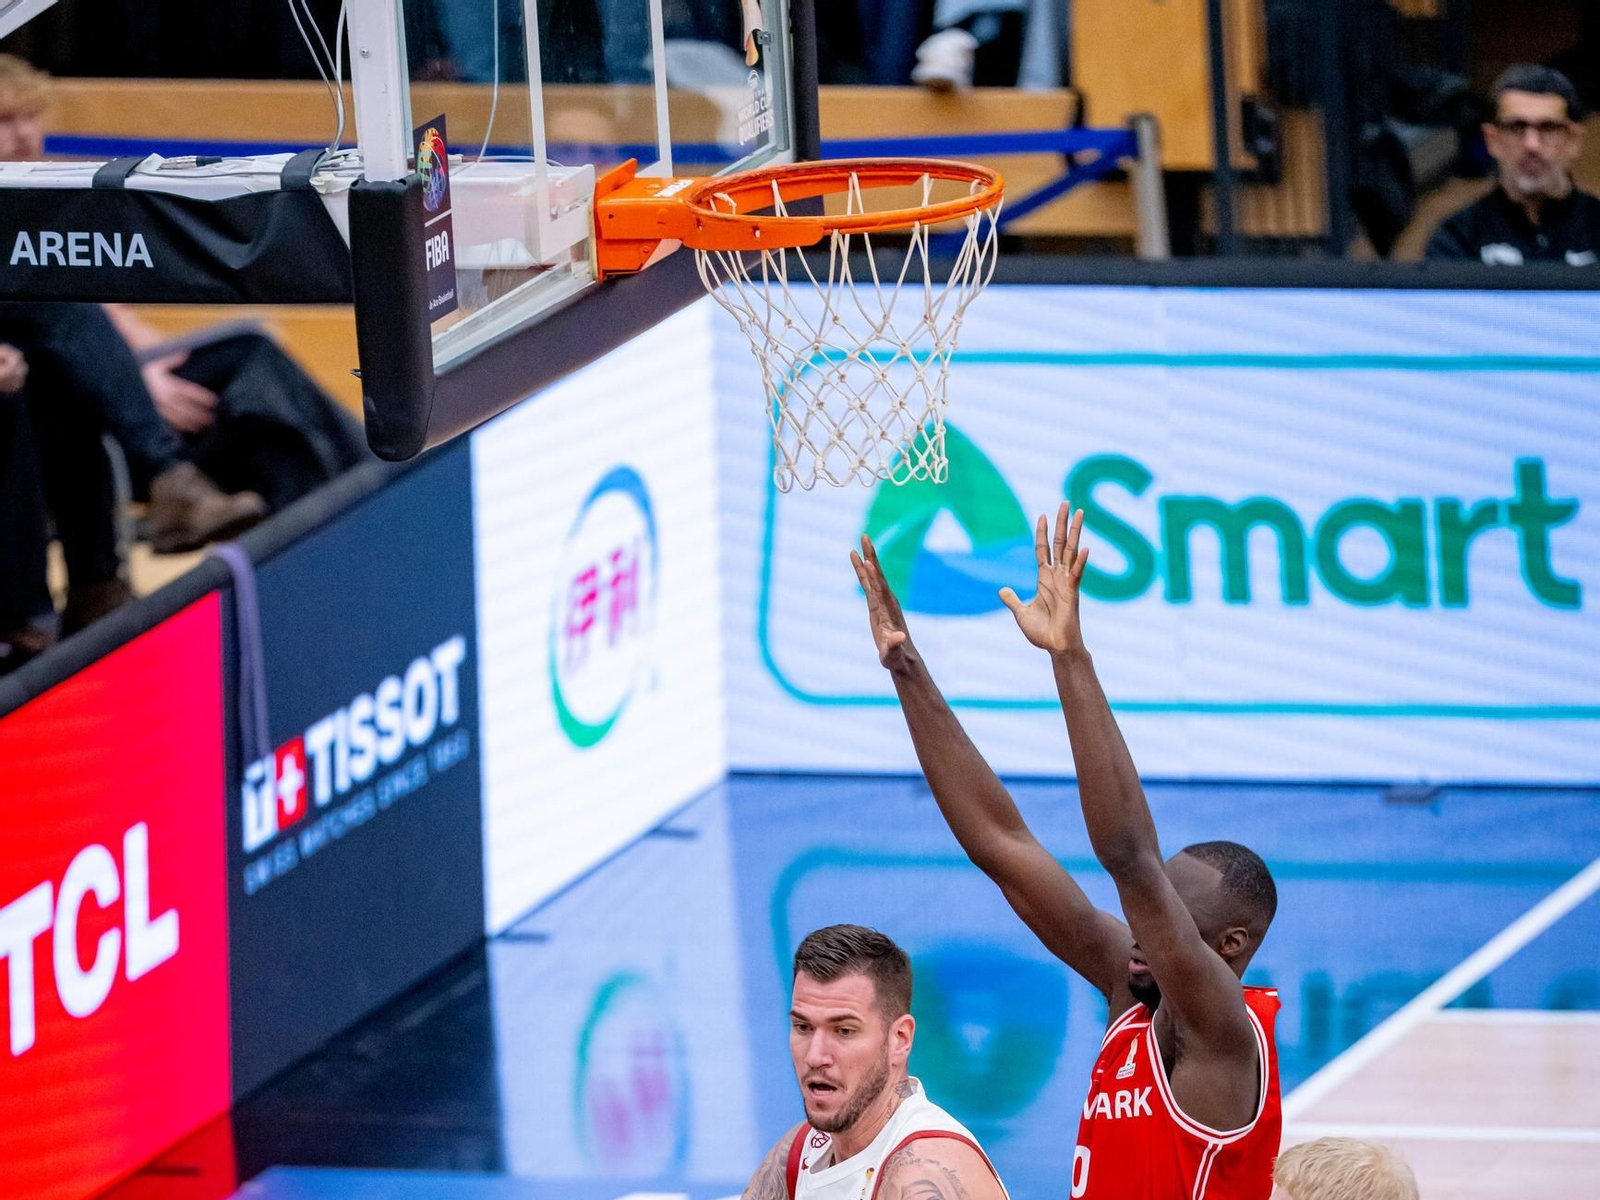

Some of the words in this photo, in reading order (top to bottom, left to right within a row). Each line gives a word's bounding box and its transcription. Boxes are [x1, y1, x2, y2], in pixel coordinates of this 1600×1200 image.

[9, 230, 155, 268] ARENA
[425, 230, 450, 272] FIBA
[1064, 453, 1582, 610] Smart
[305, 634, 467, 808] TISSOT
[0, 821, 180, 1057] TCL
